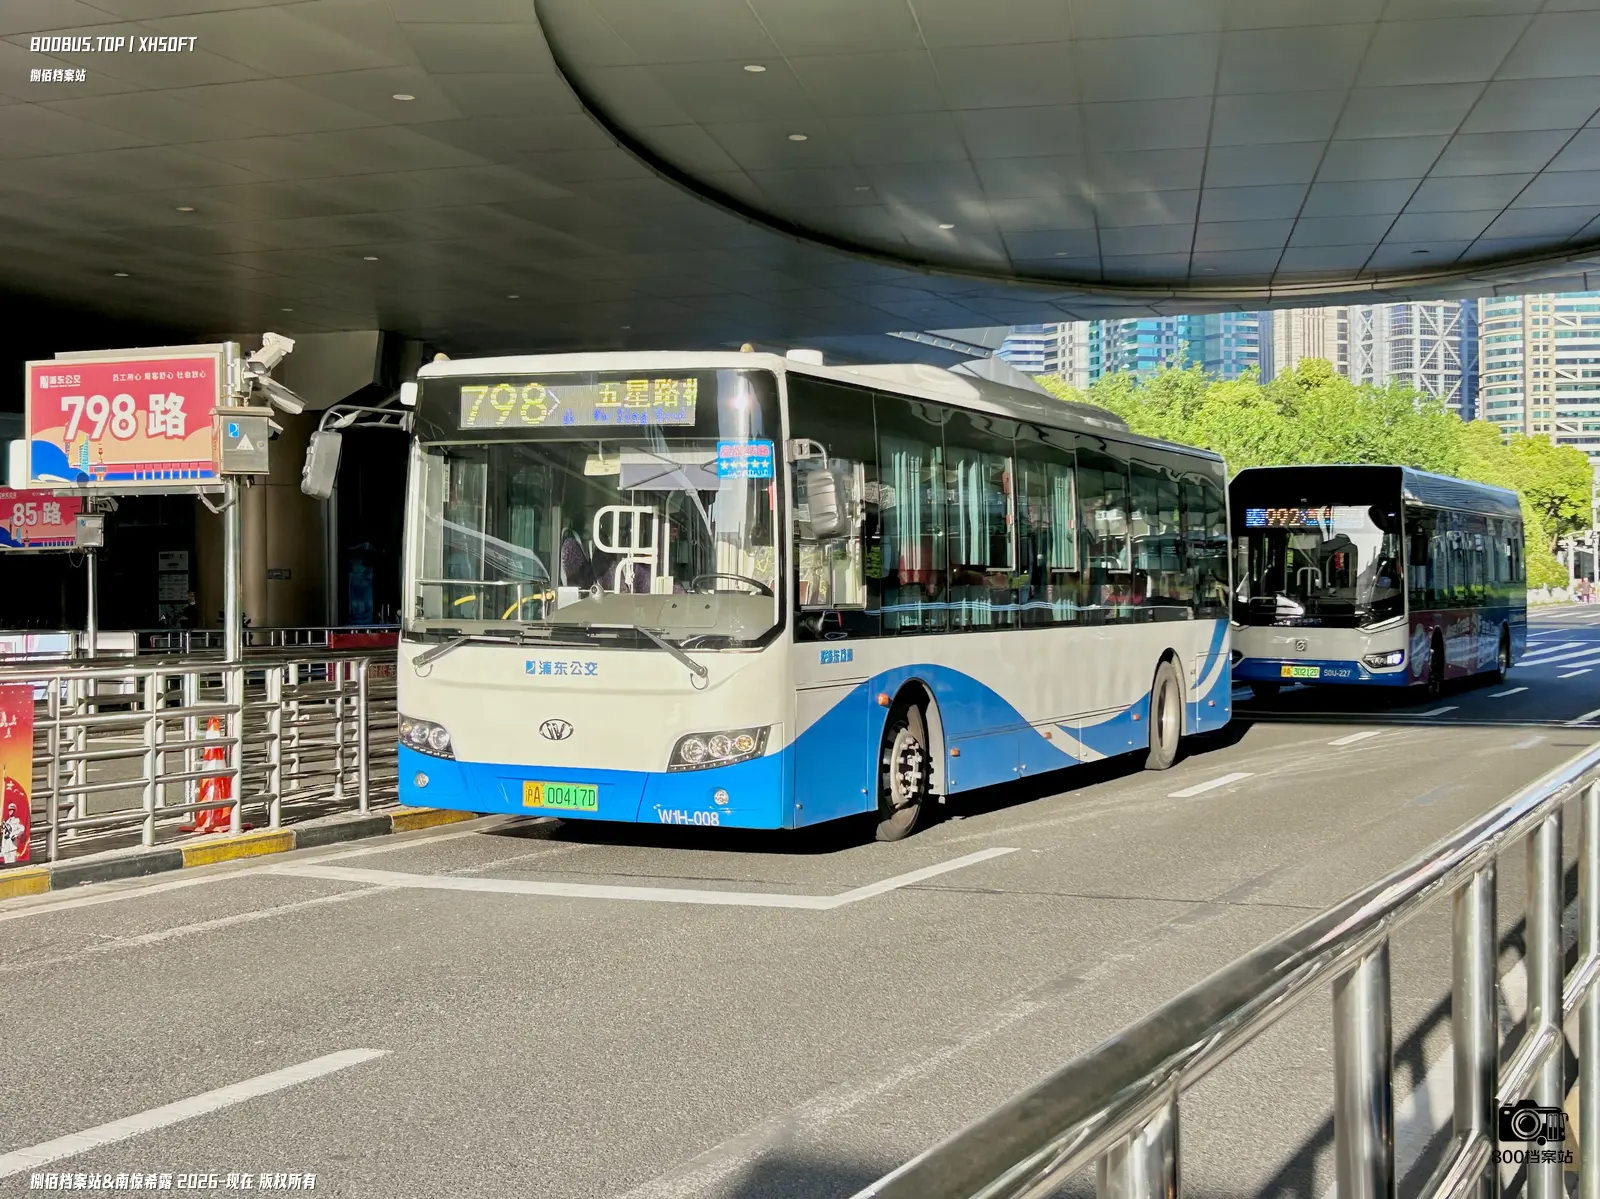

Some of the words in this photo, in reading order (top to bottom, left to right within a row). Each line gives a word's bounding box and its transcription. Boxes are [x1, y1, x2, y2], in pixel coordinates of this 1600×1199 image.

[61, 393, 137, 440] 798
[147, 391, 188, 438] 路
[460, 382, 548, 425] 798
[42, 501, 62, 525] 路
[538, 660, 598, 676] 浦东公交
